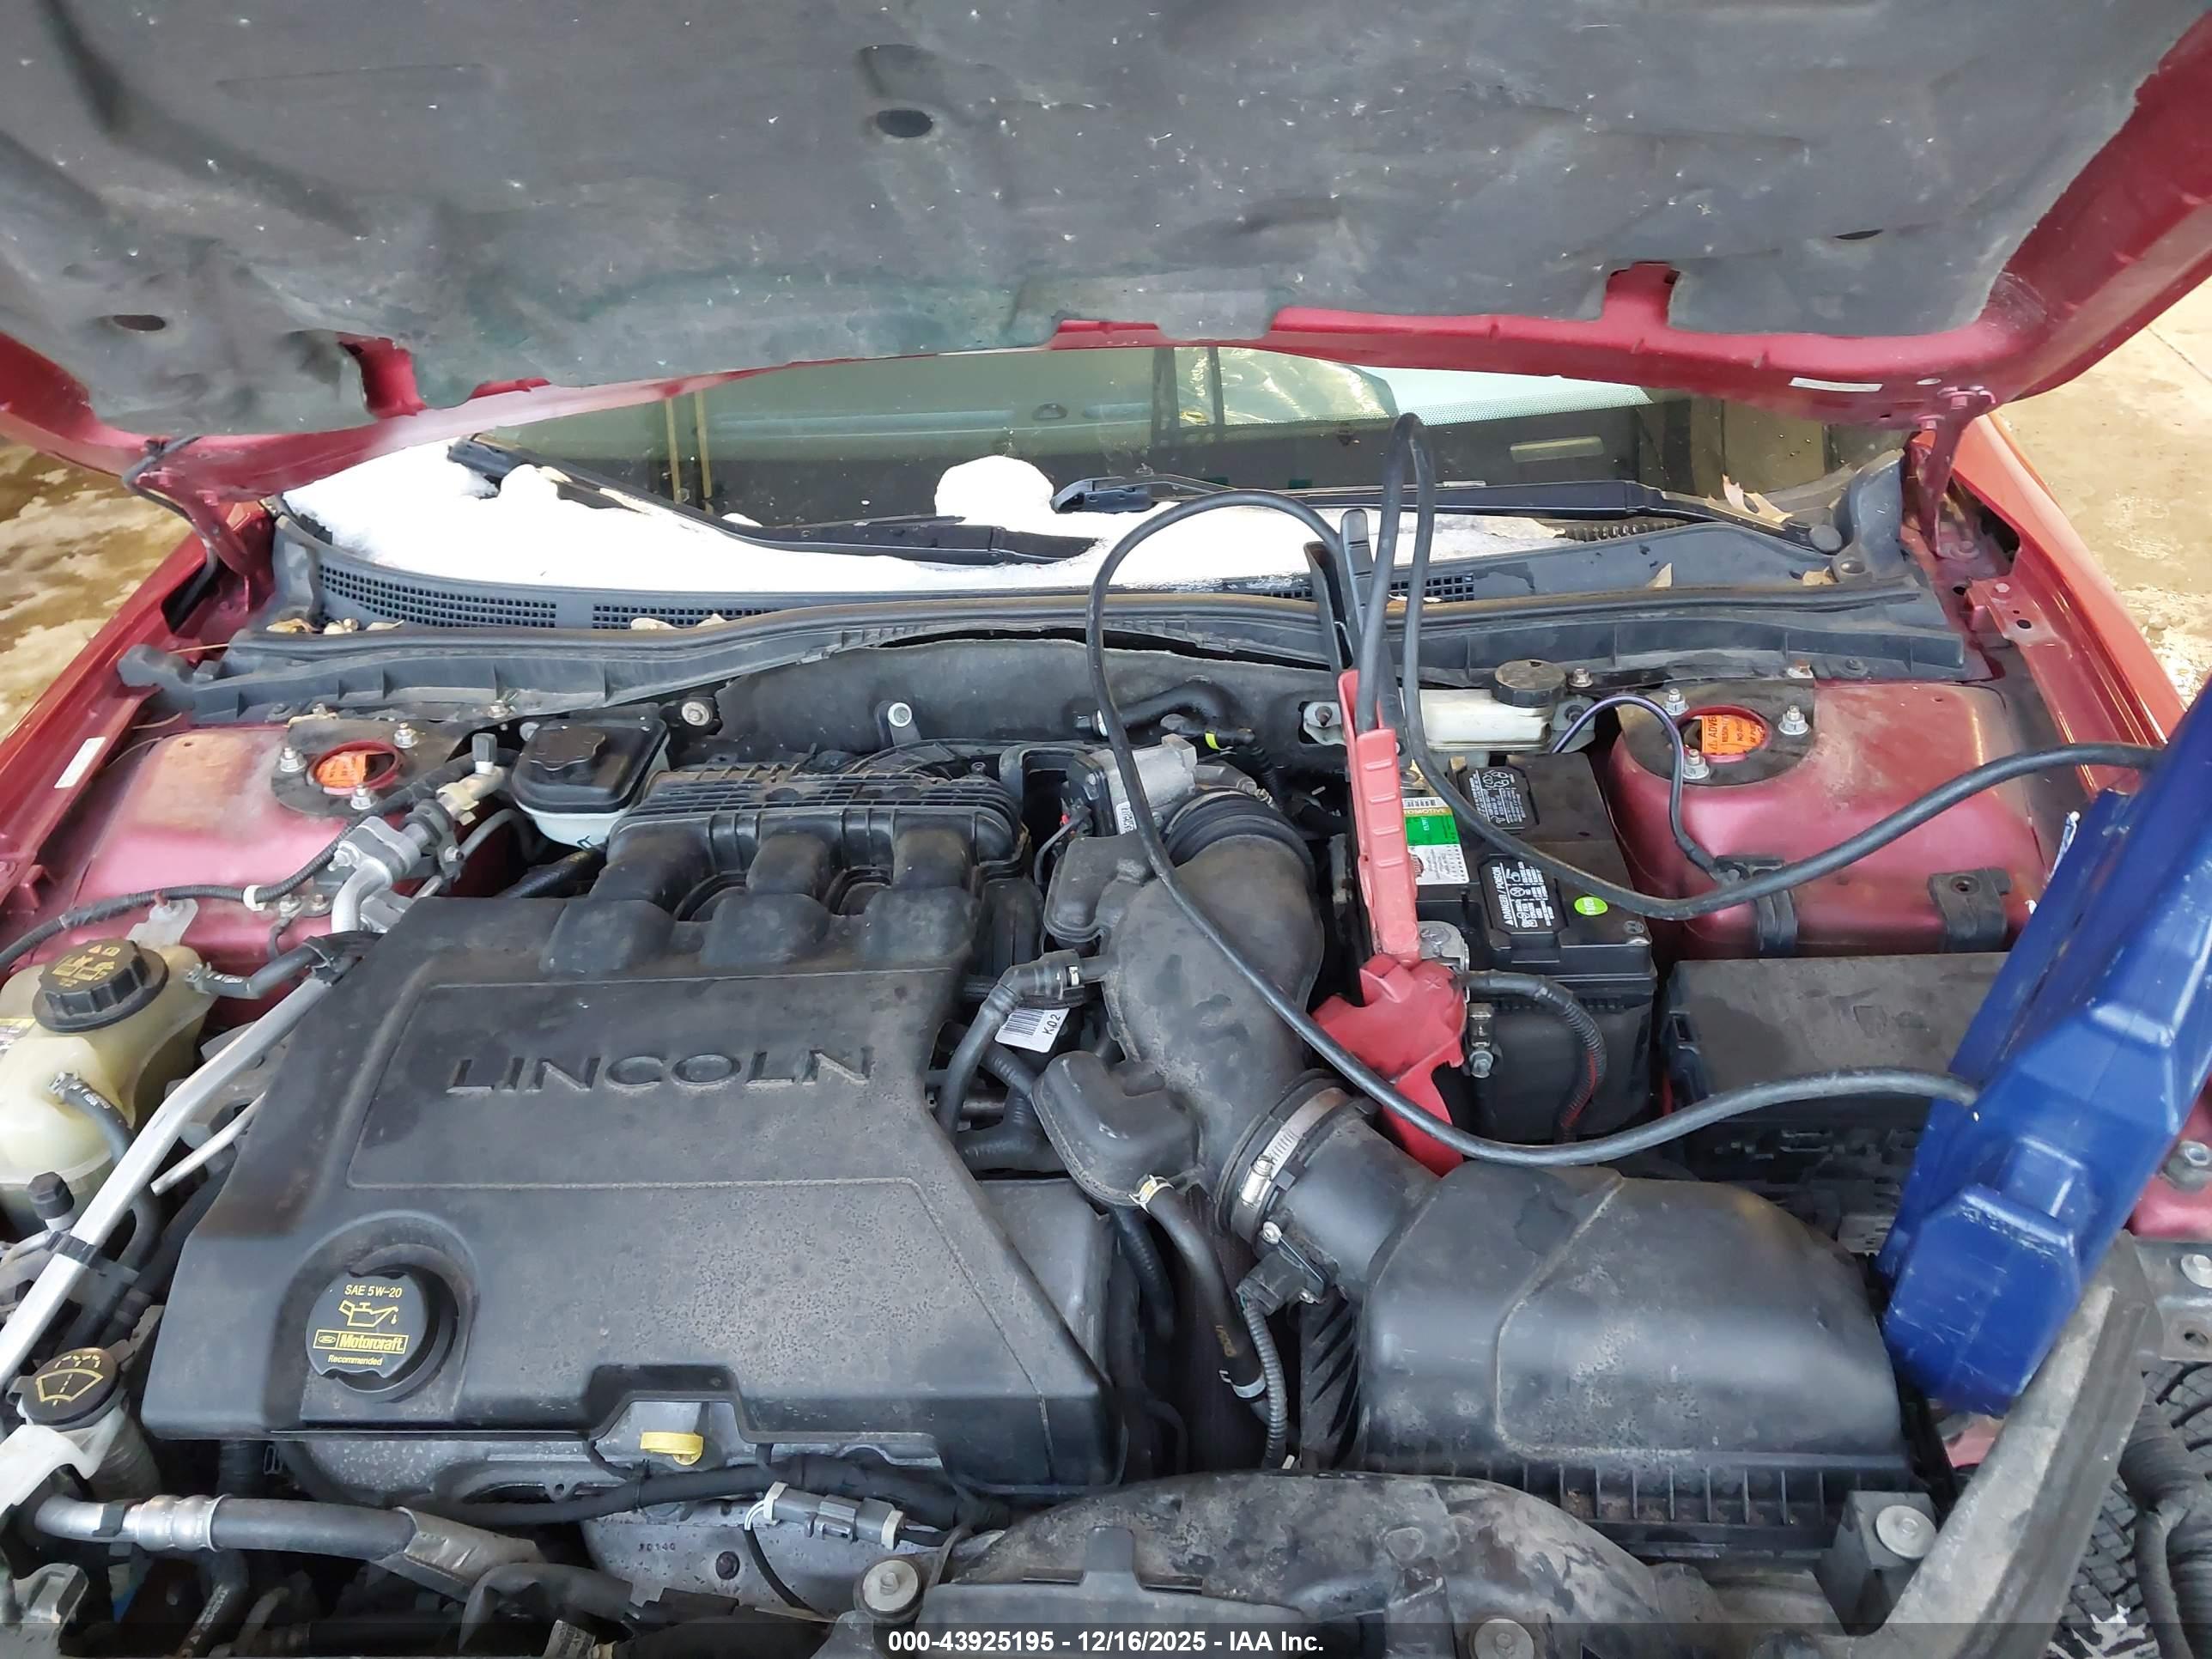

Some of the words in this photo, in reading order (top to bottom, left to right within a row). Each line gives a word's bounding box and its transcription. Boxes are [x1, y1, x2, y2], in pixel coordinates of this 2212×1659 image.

[1708, 714, 1718, 738] ADVE
[1491, 866, 1505, 889] POISON
[1498, 894, 1512, 920] DANGER
[1042, 1014, 1060, 1035] K02
[447, 1046, 874, 1097] LINCOLN
[344, 1285, 366, 1296] SAE
[367, 1286, 403, 1298] 5W-20
[339, 1334, 404, 1352] Motorcraft
[327, 1354, 383, 1366] Recommended
